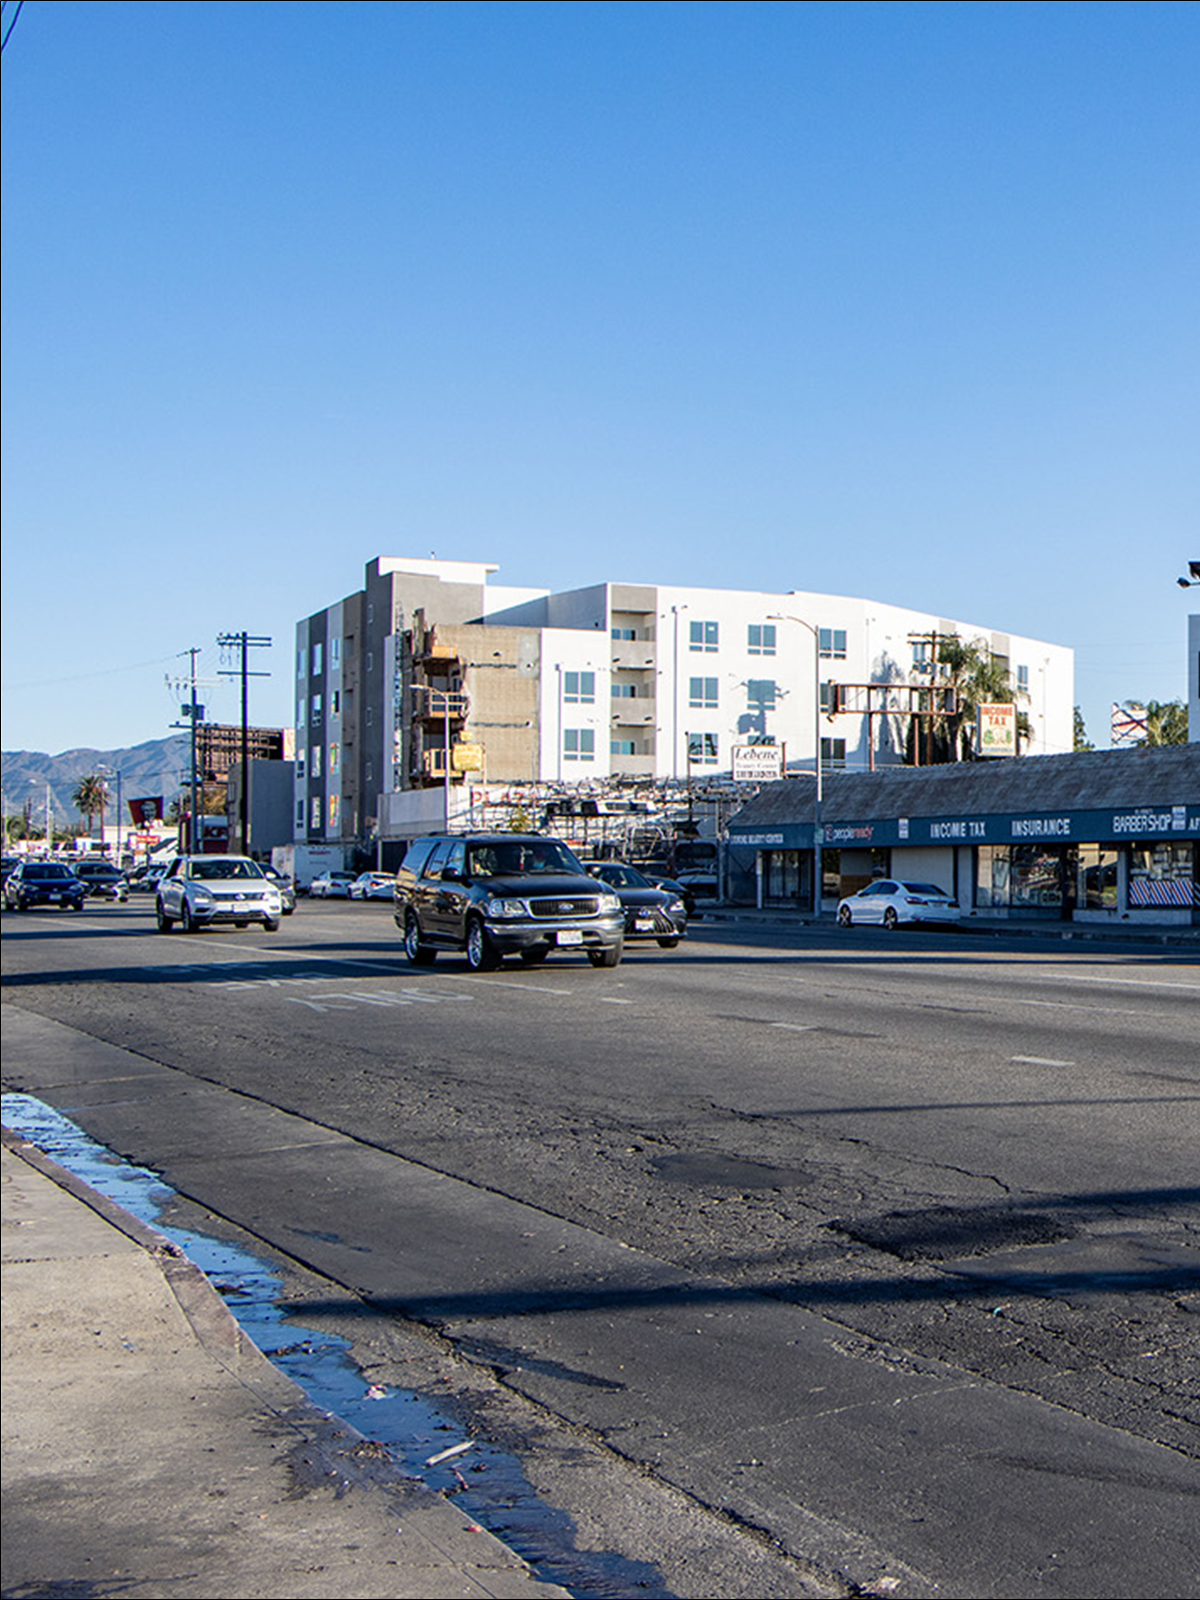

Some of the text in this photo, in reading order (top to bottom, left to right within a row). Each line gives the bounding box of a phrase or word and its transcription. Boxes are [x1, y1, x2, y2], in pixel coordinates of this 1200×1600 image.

[989, 716, 1006, 725] TAX
[930, 822, 986, 838] INCOME TAX
[1011, 818, 1071, 836] INSURANCE
